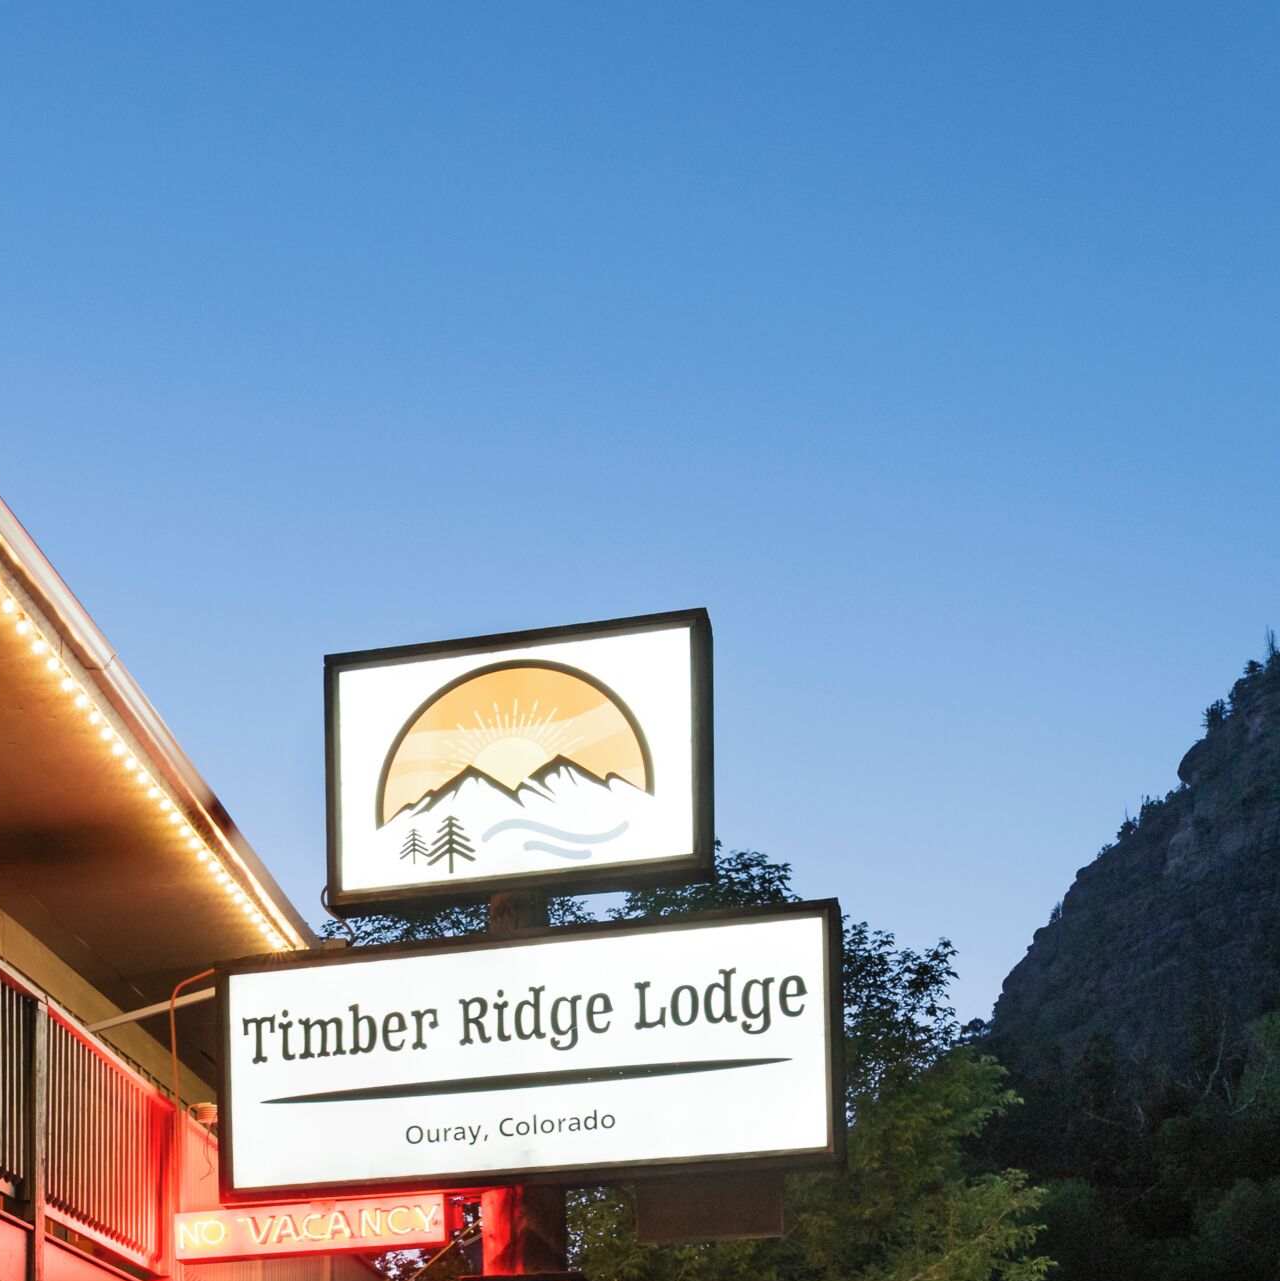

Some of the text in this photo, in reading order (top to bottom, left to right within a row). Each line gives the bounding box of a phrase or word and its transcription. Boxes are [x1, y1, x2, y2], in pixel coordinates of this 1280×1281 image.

[242, 967, 808, 1065] Timber Ridge Lodge
[405, 1109, 617, 1147] Ouray, Colorado
[177, 1203, 441, 1251] NO VACANCY
